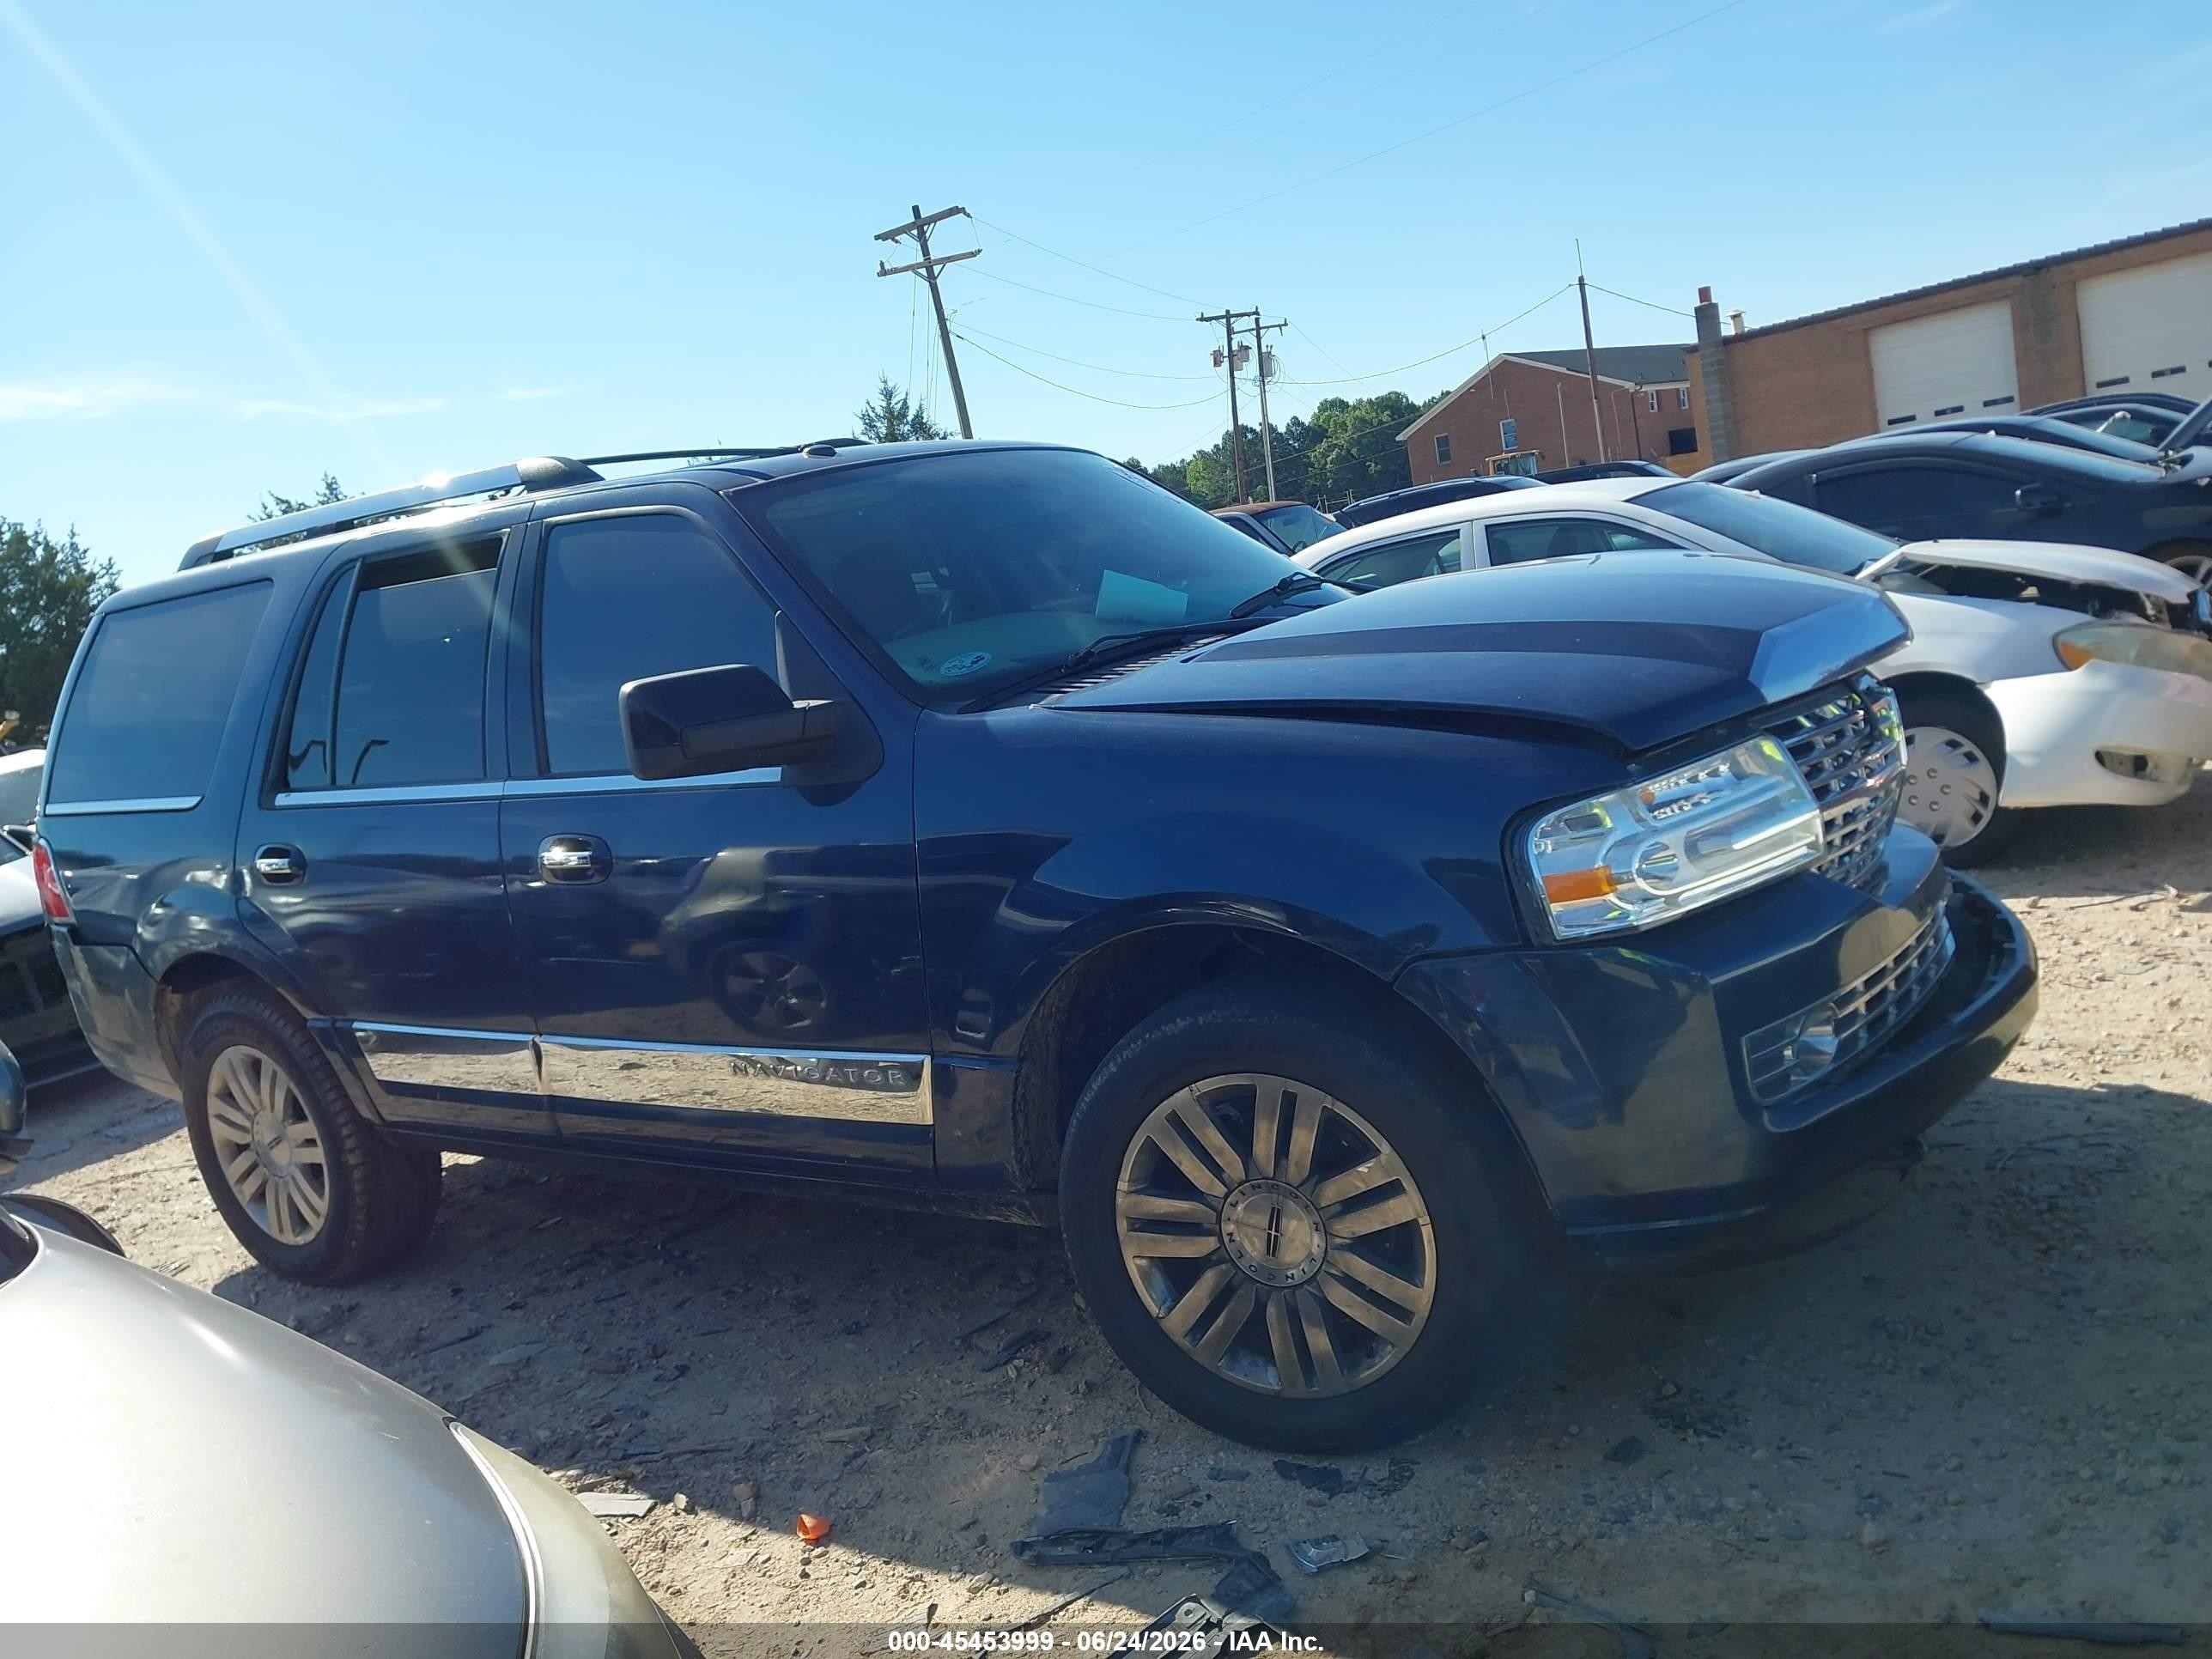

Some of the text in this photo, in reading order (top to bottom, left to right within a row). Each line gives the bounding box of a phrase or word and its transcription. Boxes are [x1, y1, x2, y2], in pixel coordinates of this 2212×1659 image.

[730, 1061, 906, 1085] NAVIGATOR
[1230, 1183, 1322, 1232] LINCOLN
[1226, 1231, 1317, 1281] LINCOLN
